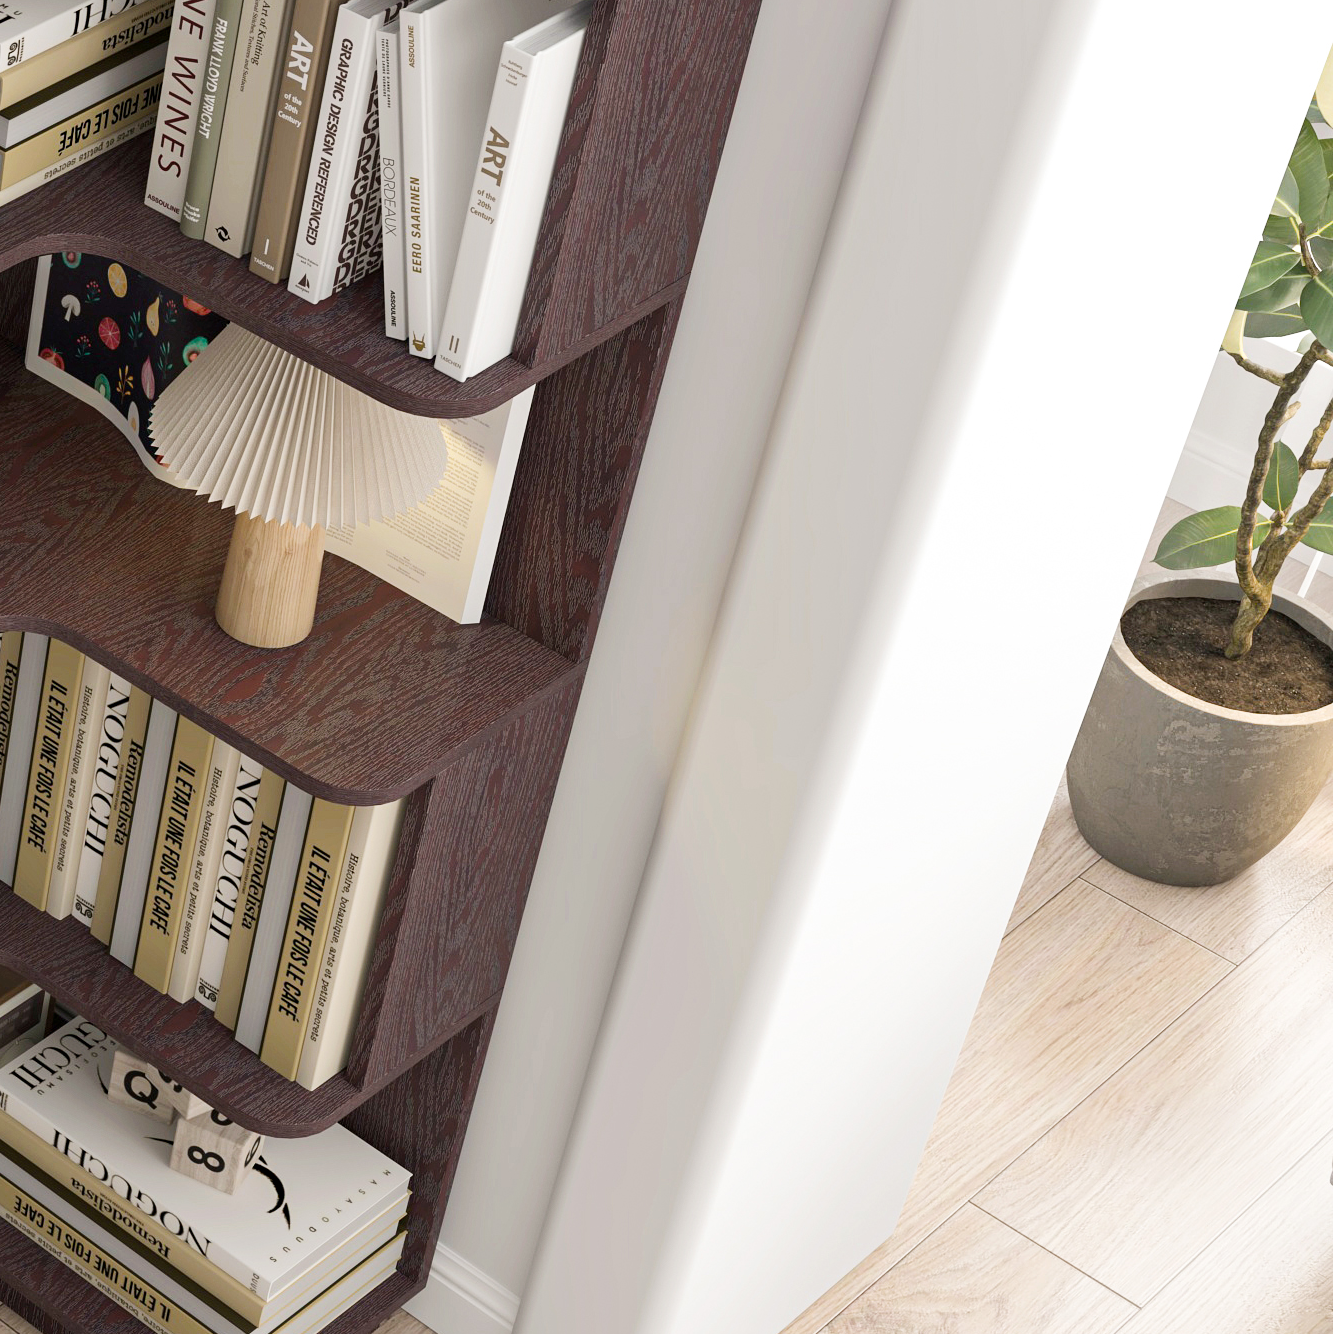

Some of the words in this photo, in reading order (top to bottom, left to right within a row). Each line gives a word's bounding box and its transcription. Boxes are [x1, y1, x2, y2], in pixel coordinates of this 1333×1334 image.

[286, 30, 314, 92] ART
[158, 55, 202, 179] WINES
[381, 157, 397, 237] BORDEAUX
[84, 683, 130, 857] NOGUCHI
[113, 740, 143, 847] Remodelista
[209, 764, 261, 941] NOGUCHI
[241, 821, 276, 930] Remodelista
[123, 1069, 160, 1110] Q
[52, 1128, 213, 1258] NOGUCHI
[71, 1176, 172, 1260] Remodelista
